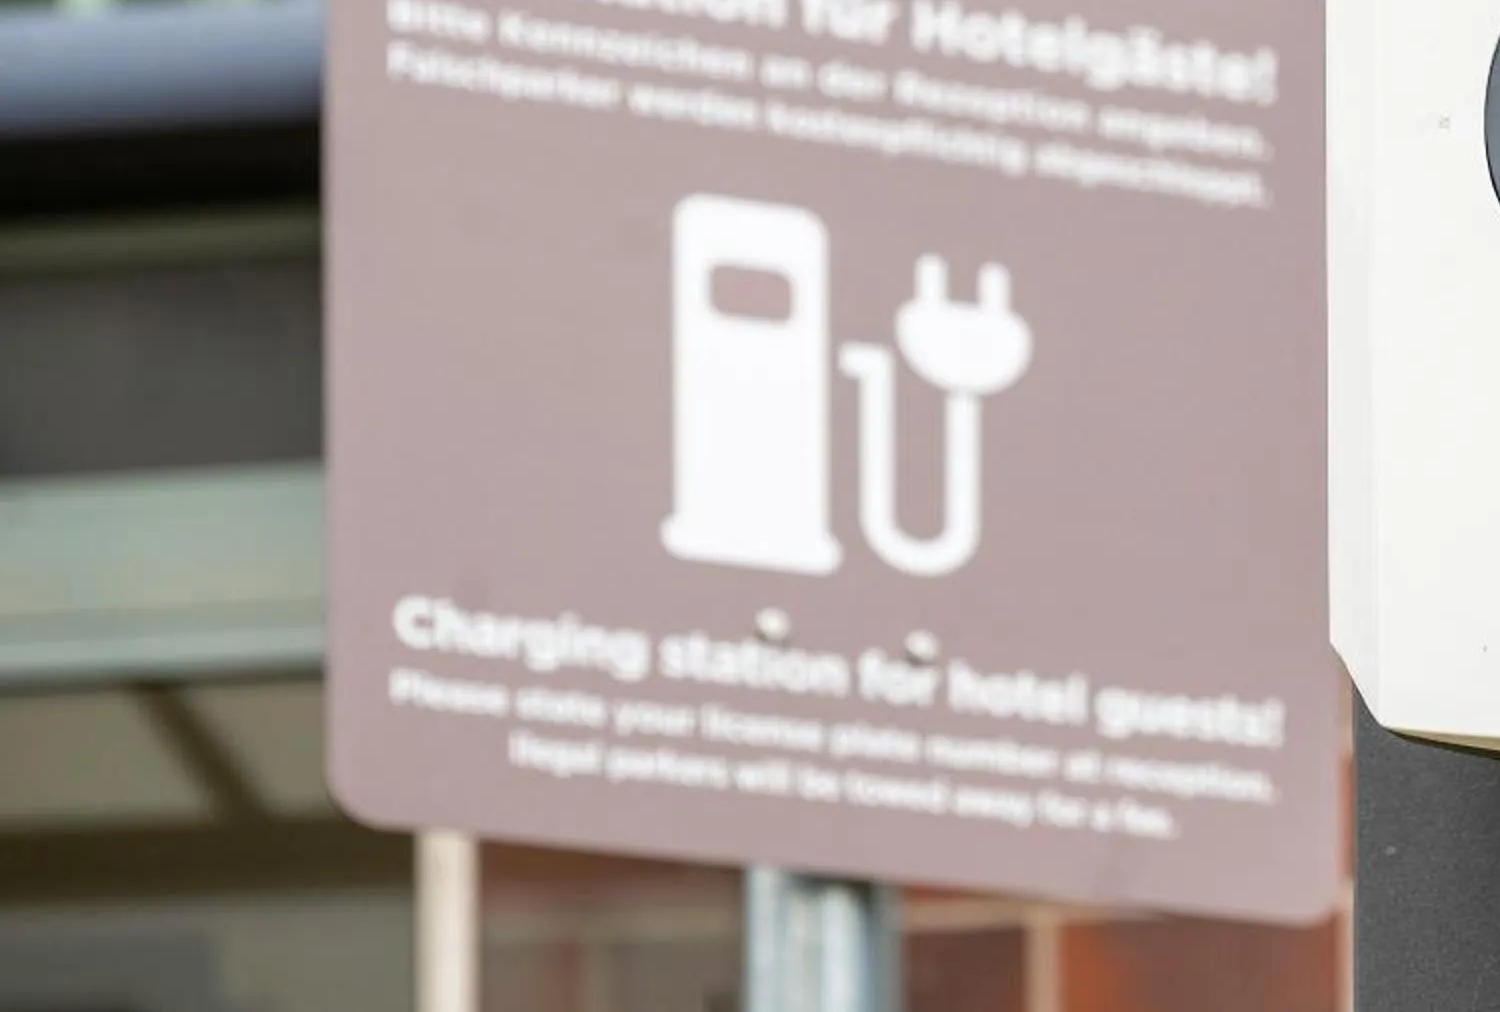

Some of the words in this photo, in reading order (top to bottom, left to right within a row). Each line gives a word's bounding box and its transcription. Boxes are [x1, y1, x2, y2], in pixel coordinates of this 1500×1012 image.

[393, 595, 650, 682] Charging
[658, 628, 850, 697] station
[859, 648, 942, 709] for
[947, 657, 1088, 726] hotel
[1096, 685, 1284, 750] guests!
